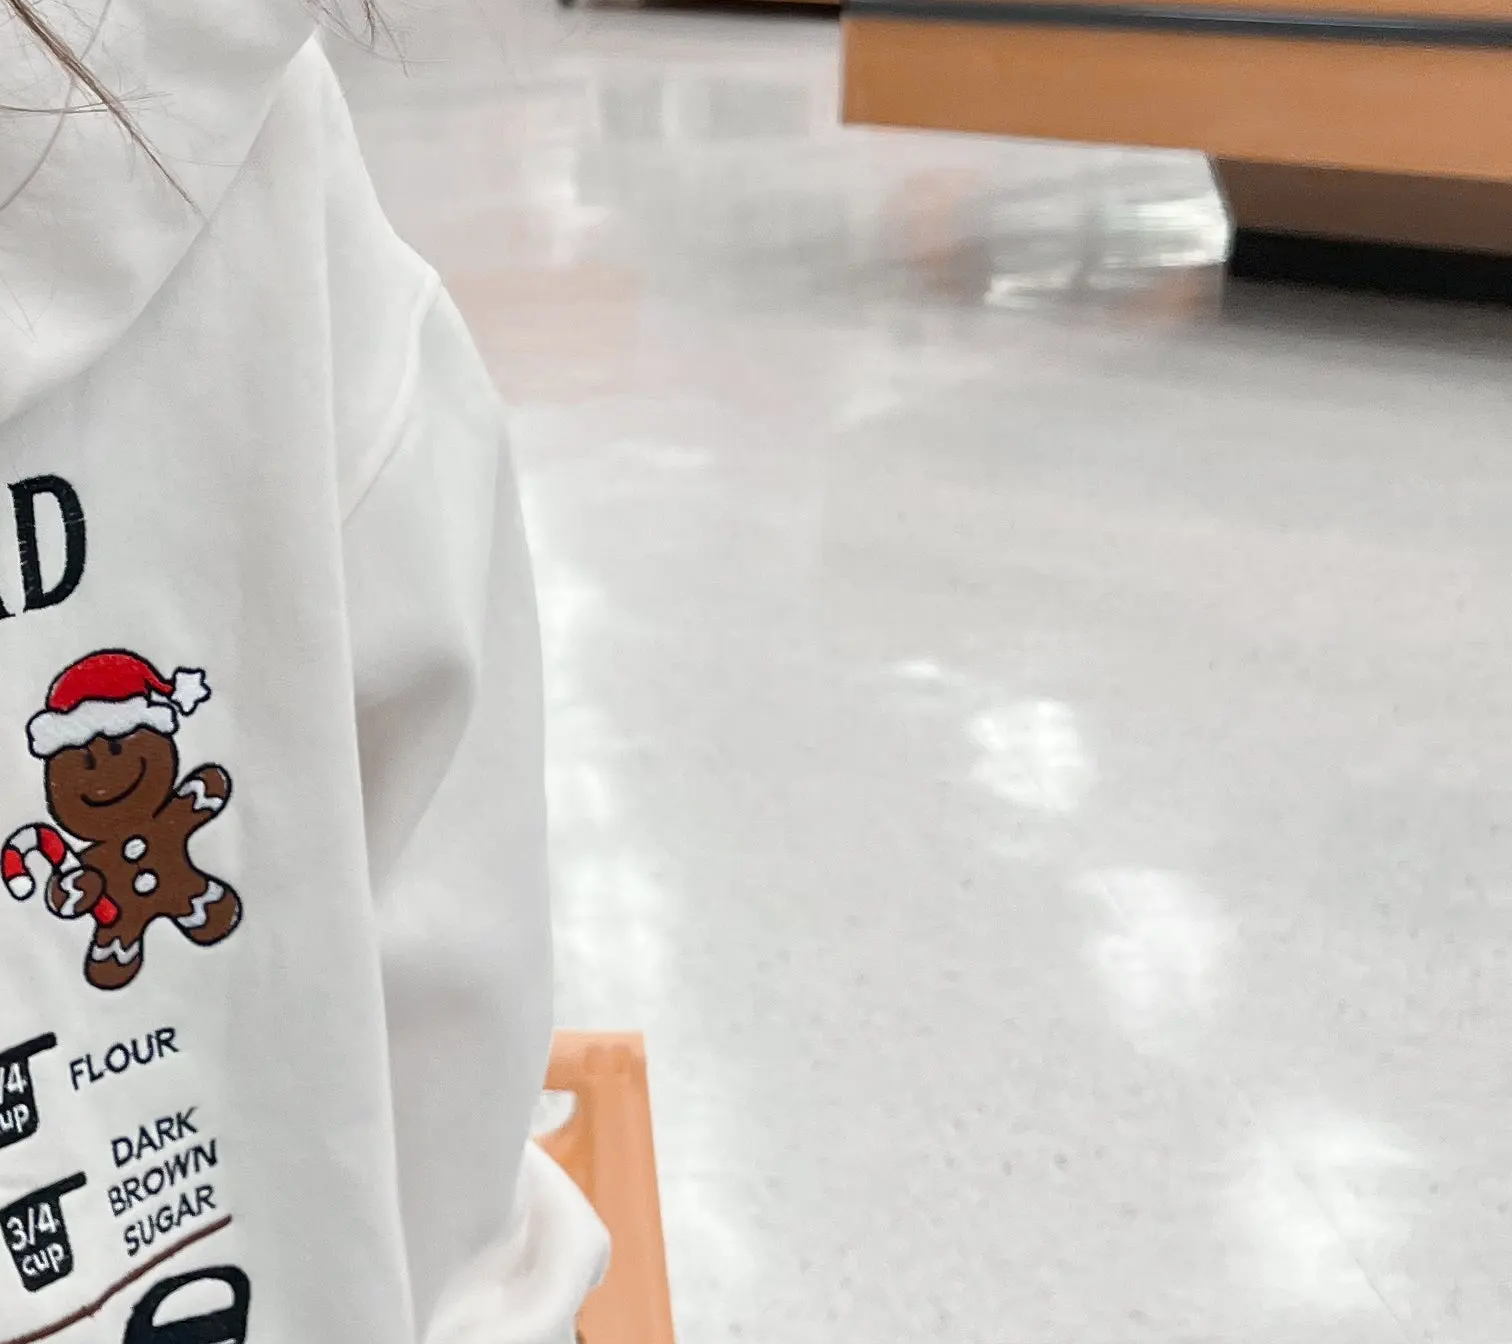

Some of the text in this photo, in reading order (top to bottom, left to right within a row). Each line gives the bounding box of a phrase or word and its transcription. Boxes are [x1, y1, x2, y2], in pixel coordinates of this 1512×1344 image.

[69, 1027, 179, 1091] FLOUR
[111, 1106, 199, 1167] DARK
[107, 1138, 218, 1217] BROWN
[5, 1202, 61, 1253] 3/4
[124, 1183, 217, 1257] SUGAR
[21, 1241, 65, 1277] cup
